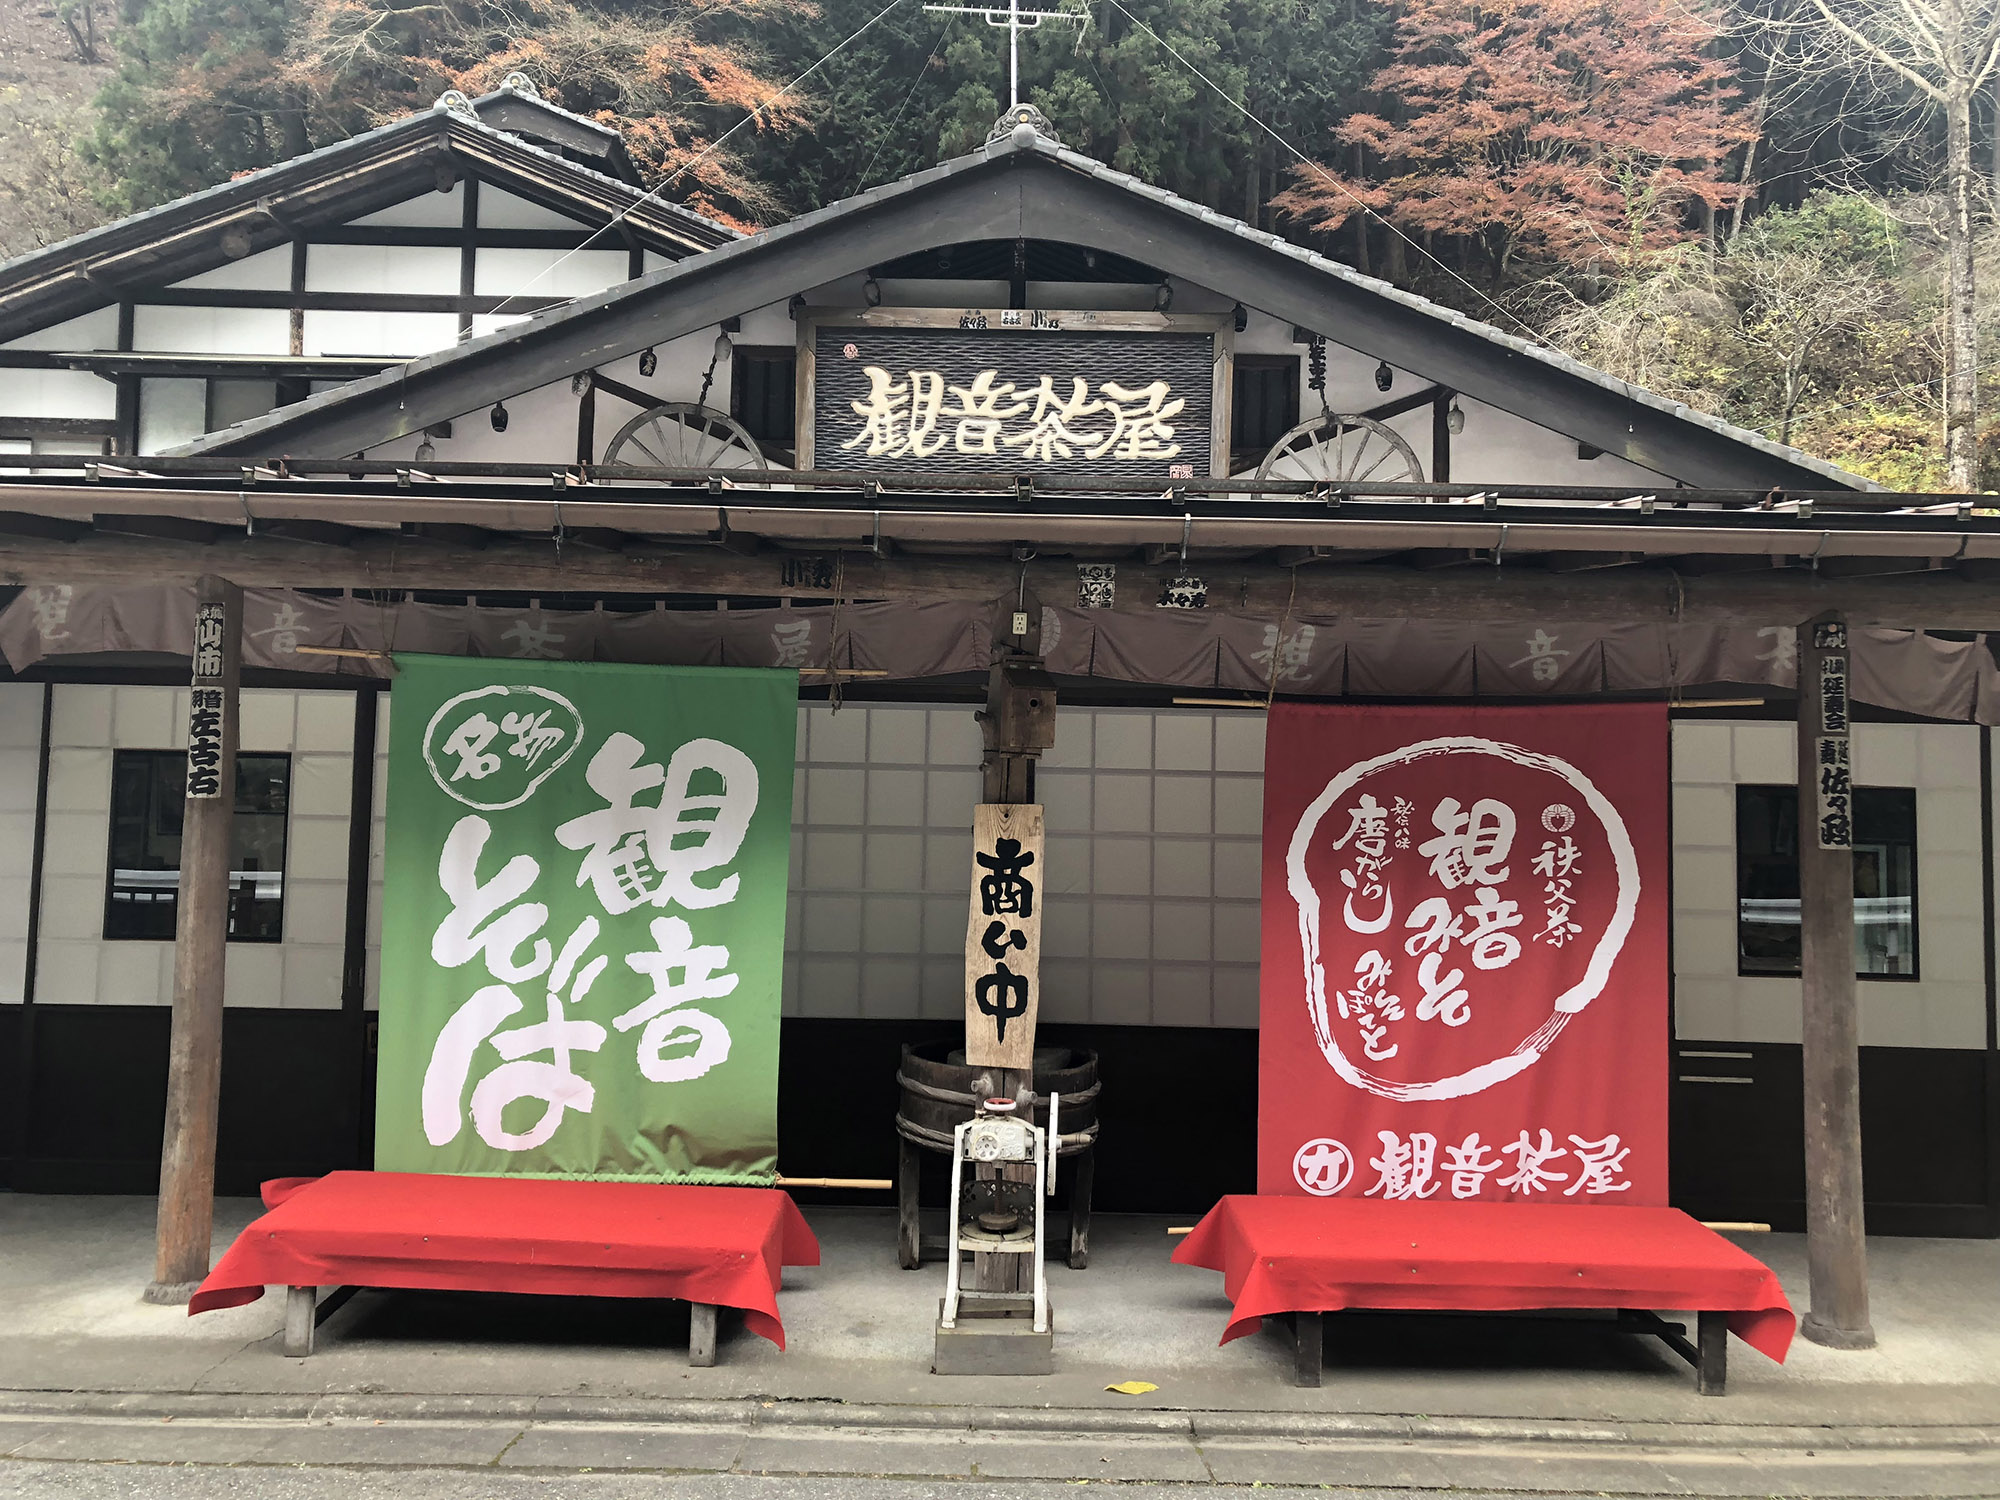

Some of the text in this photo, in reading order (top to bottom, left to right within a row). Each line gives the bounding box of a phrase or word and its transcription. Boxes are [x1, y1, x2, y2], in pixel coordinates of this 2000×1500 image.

[840, 365, 1186, 462] 観音茶屋
[442, 708, 565, 782] 名物
[1332, 793, 1394, 935] 唐がらし
[1390, 795, 1416, 850] 秘伝八味
[975, 837, 1035, 1045] 商い中
[1363, 1128, 1632, 1200] 観音茶屋
